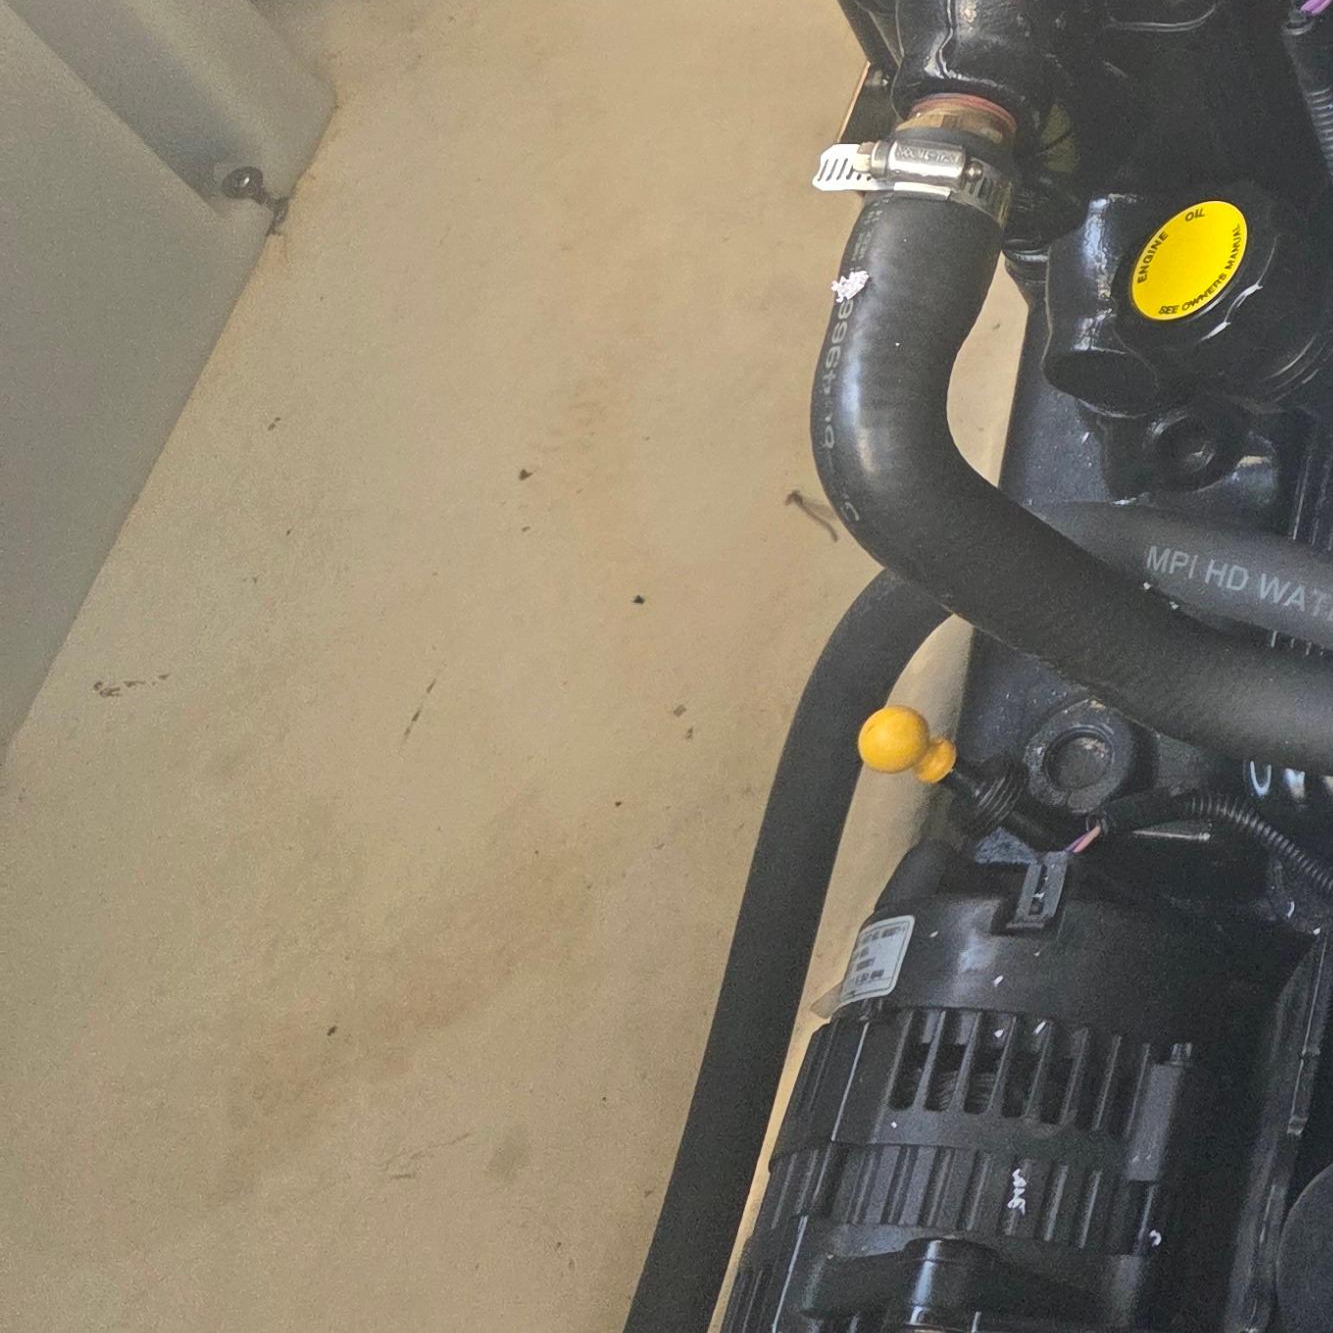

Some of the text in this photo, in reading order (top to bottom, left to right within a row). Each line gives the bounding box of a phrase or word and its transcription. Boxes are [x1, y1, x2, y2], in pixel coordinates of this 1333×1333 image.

[1137, 208, 1206, 284] ENGINE OIL
[1158, 223, 1241, 315] SEE OWNERS MANUAL
[1145, 544, 1199, 581] MPI
[1205, 562, 1249, 592] HD
